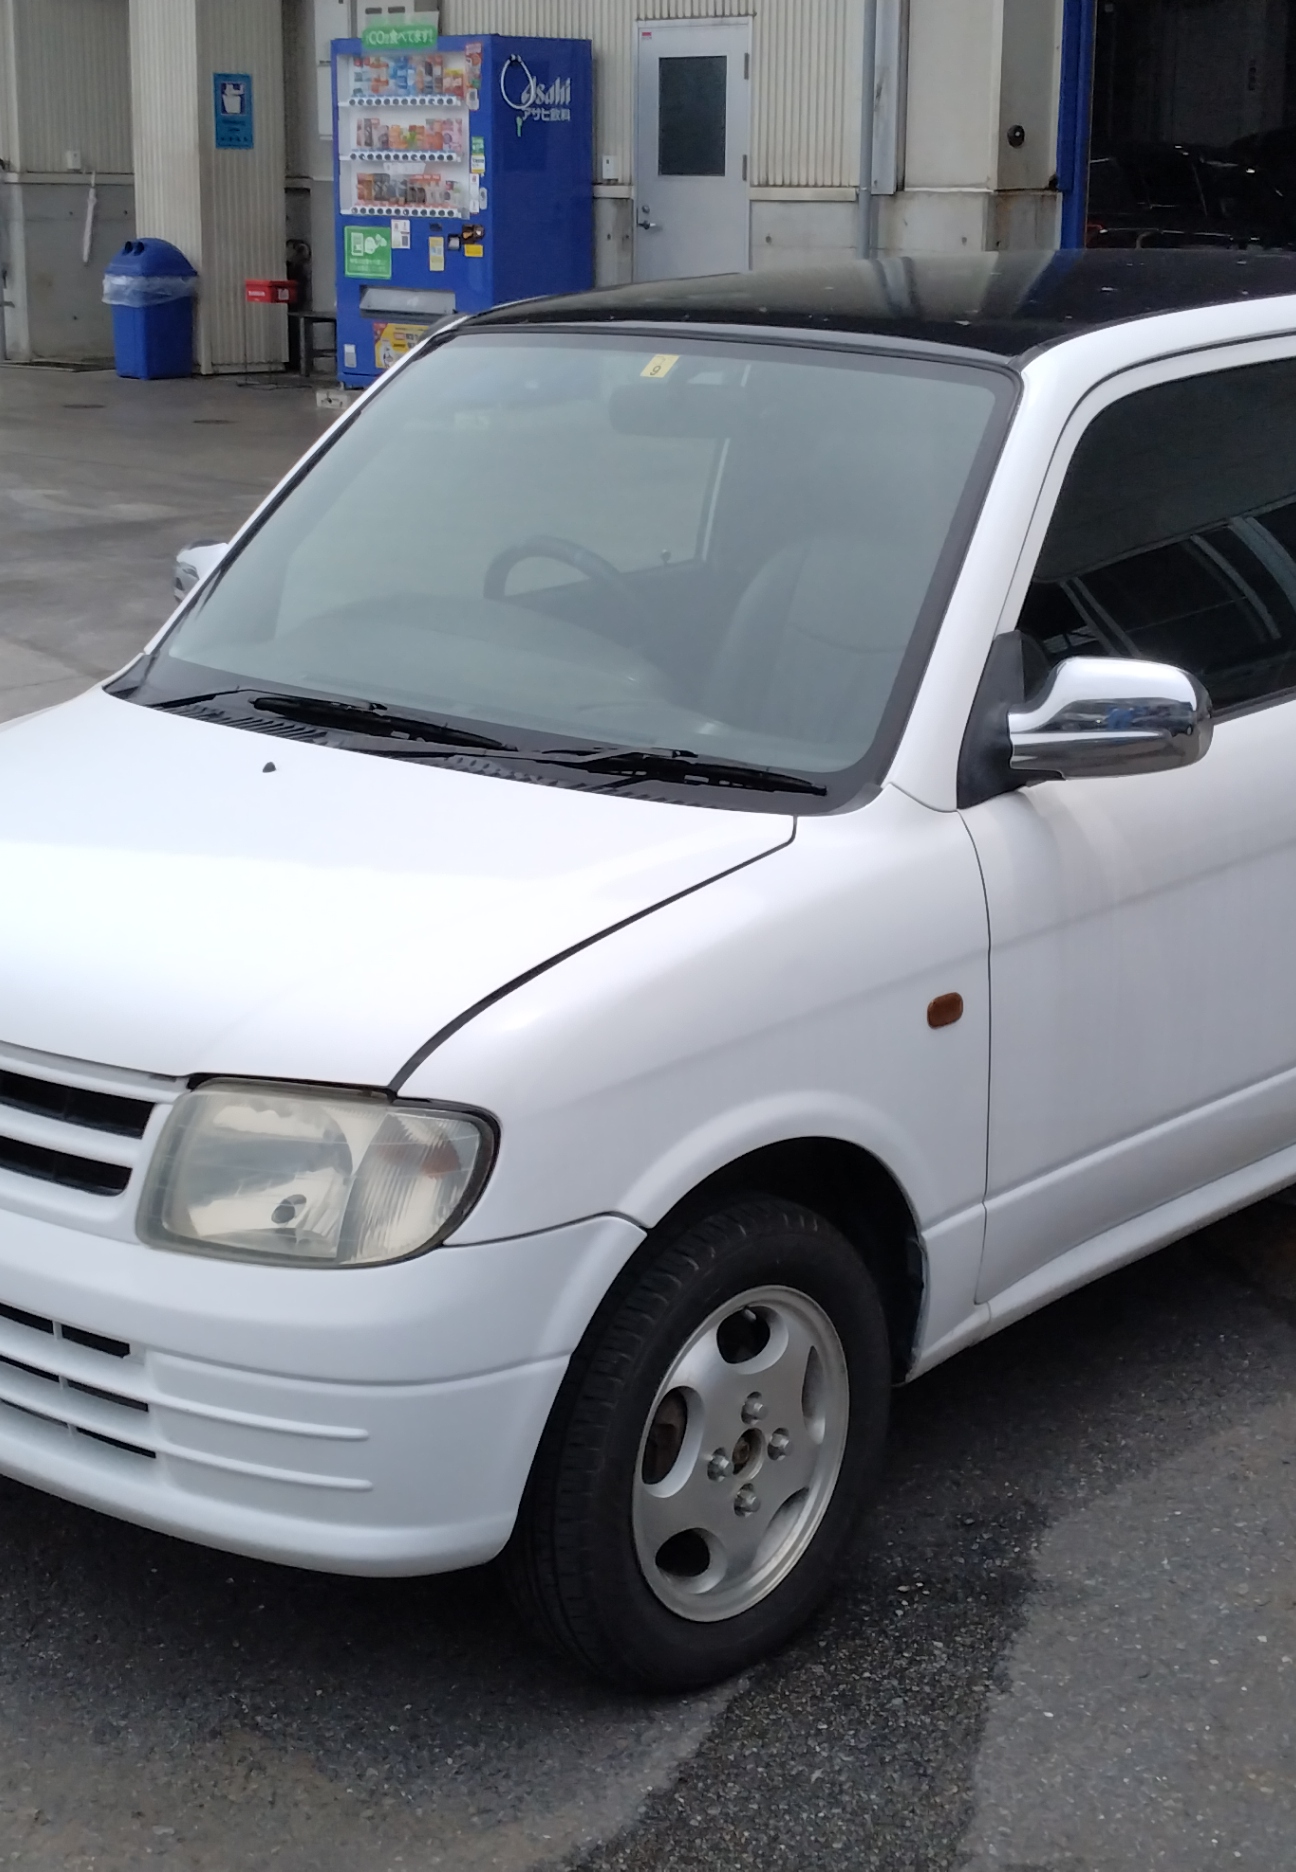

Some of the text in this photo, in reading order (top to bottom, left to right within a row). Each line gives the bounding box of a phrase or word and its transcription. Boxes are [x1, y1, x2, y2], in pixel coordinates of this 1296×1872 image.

[521, 76, 571, 105] Asahi
[522, 107, 571, 122] アサヒ飲料
